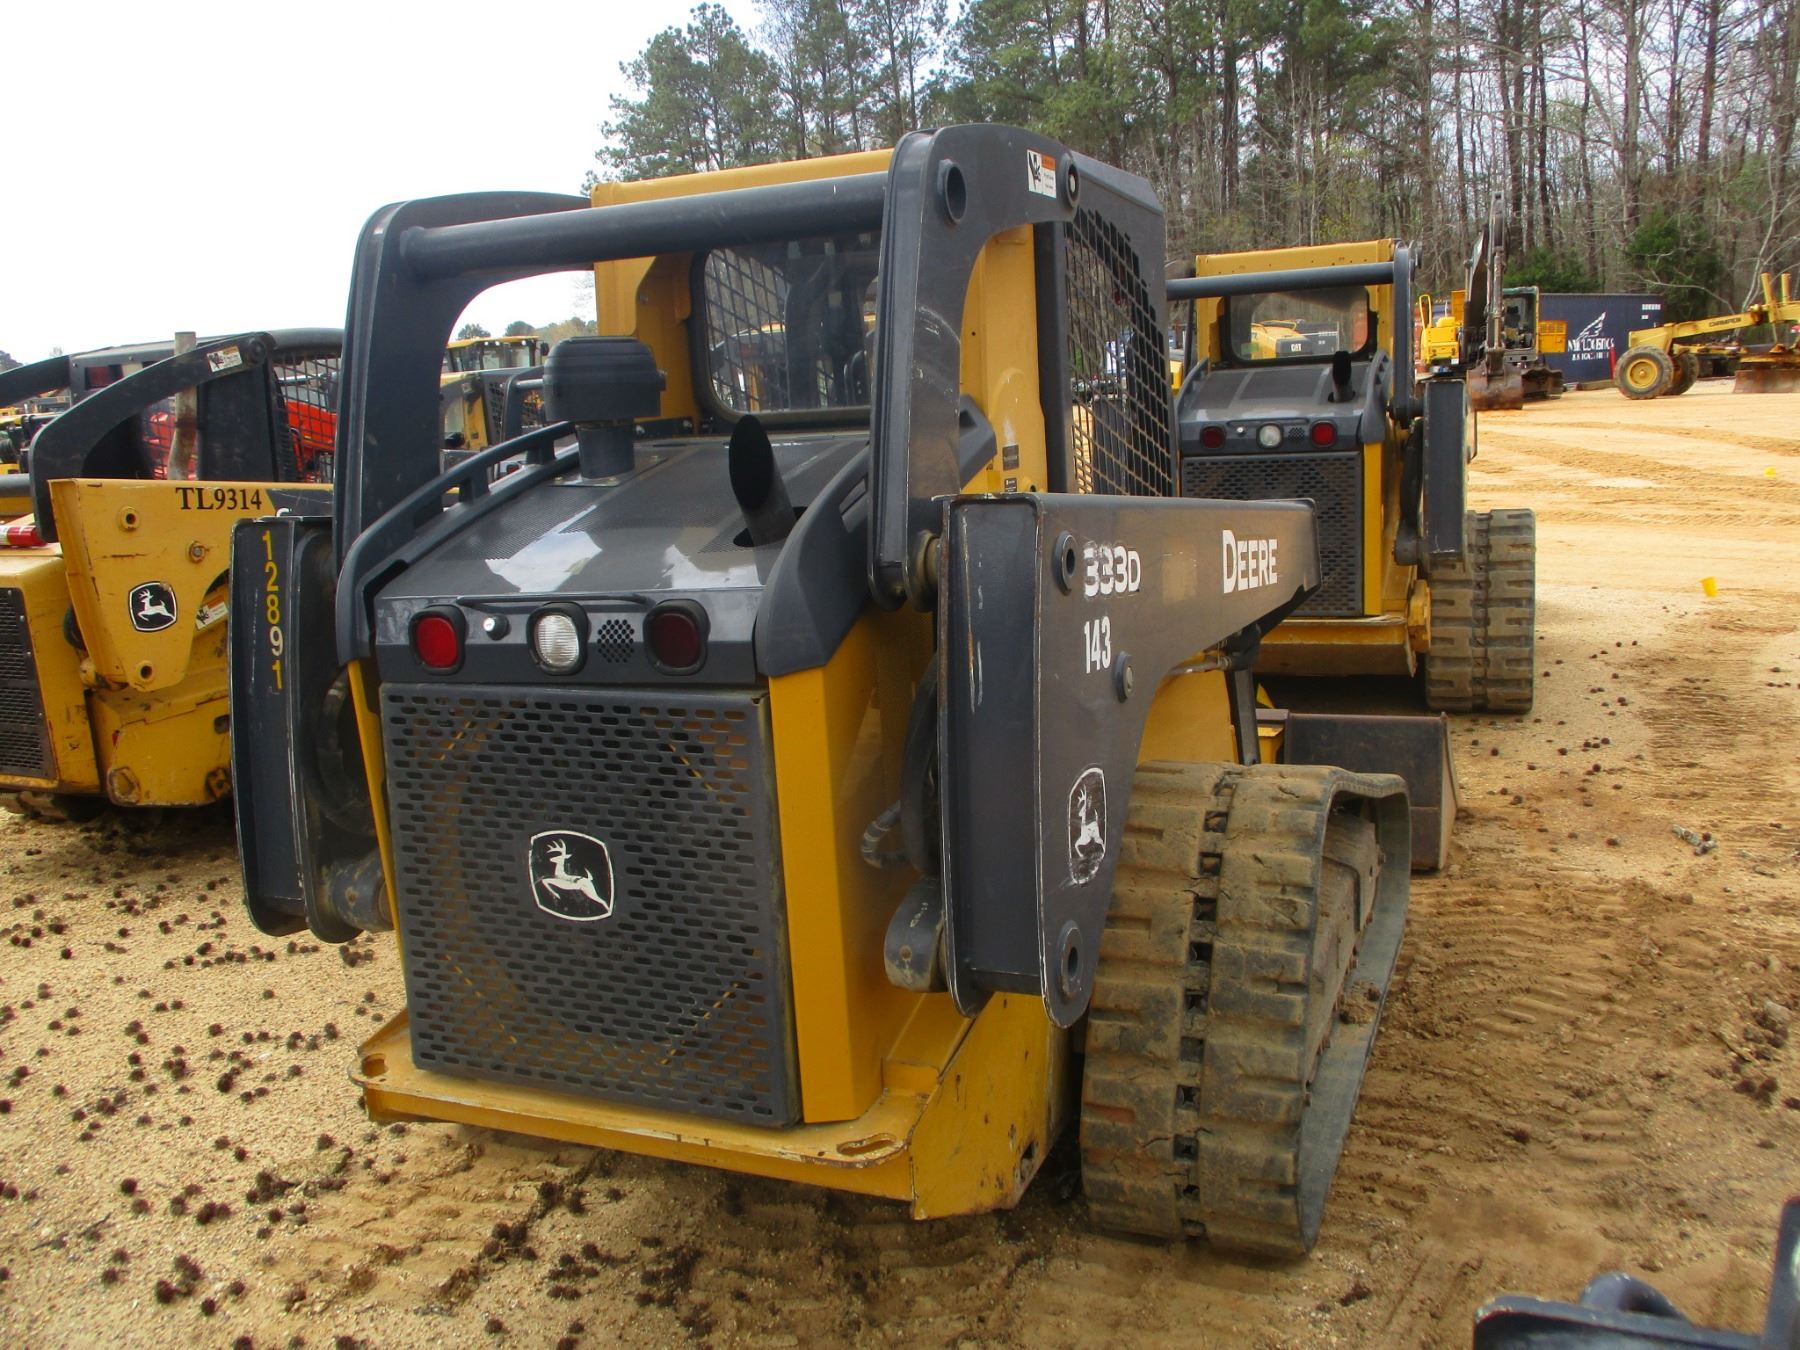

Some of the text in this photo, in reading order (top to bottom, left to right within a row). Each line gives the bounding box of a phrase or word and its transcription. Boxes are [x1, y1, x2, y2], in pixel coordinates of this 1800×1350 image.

[1290, 343, 1302, 352] CAT
[175, 486, 263, 511] TL9314
[1083, 546, 1141, 598] 333D
[1222, 529, 1278, 594] DEERE
[261, 530, 284, 690] 12891
[1083, 615, 1112, 675] 143
